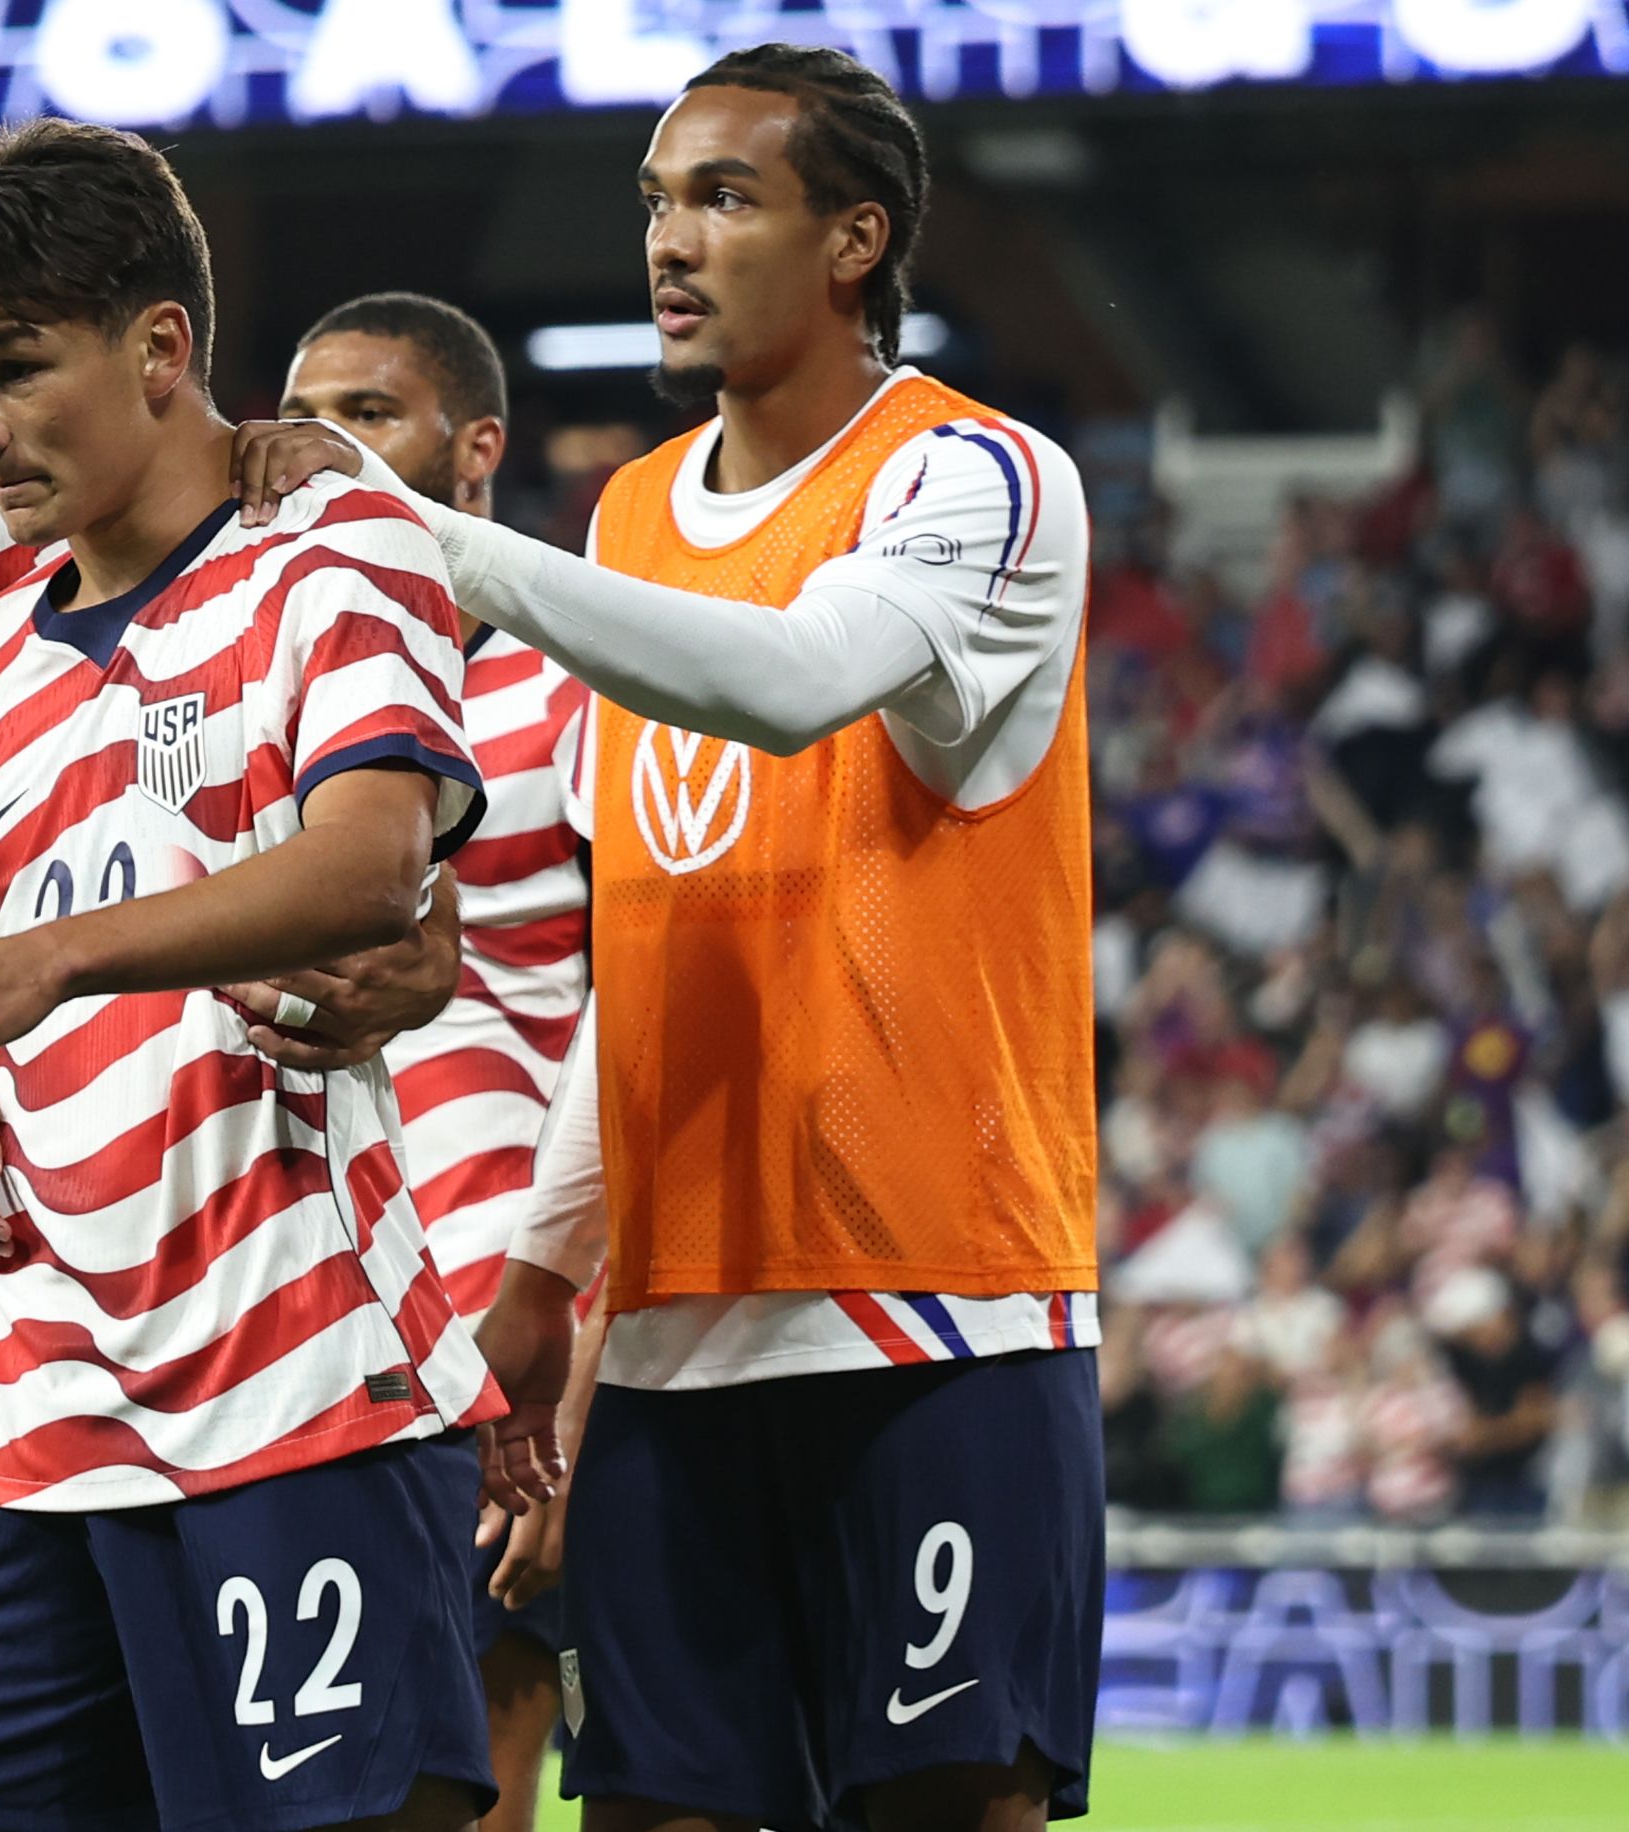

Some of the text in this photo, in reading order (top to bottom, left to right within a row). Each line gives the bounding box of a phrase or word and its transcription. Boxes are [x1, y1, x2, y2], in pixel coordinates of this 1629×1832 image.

[143, 700, 198, 747] USA
[216, 1557, 363, 1726] 22
[905, 1521, 973, 1669] 9
